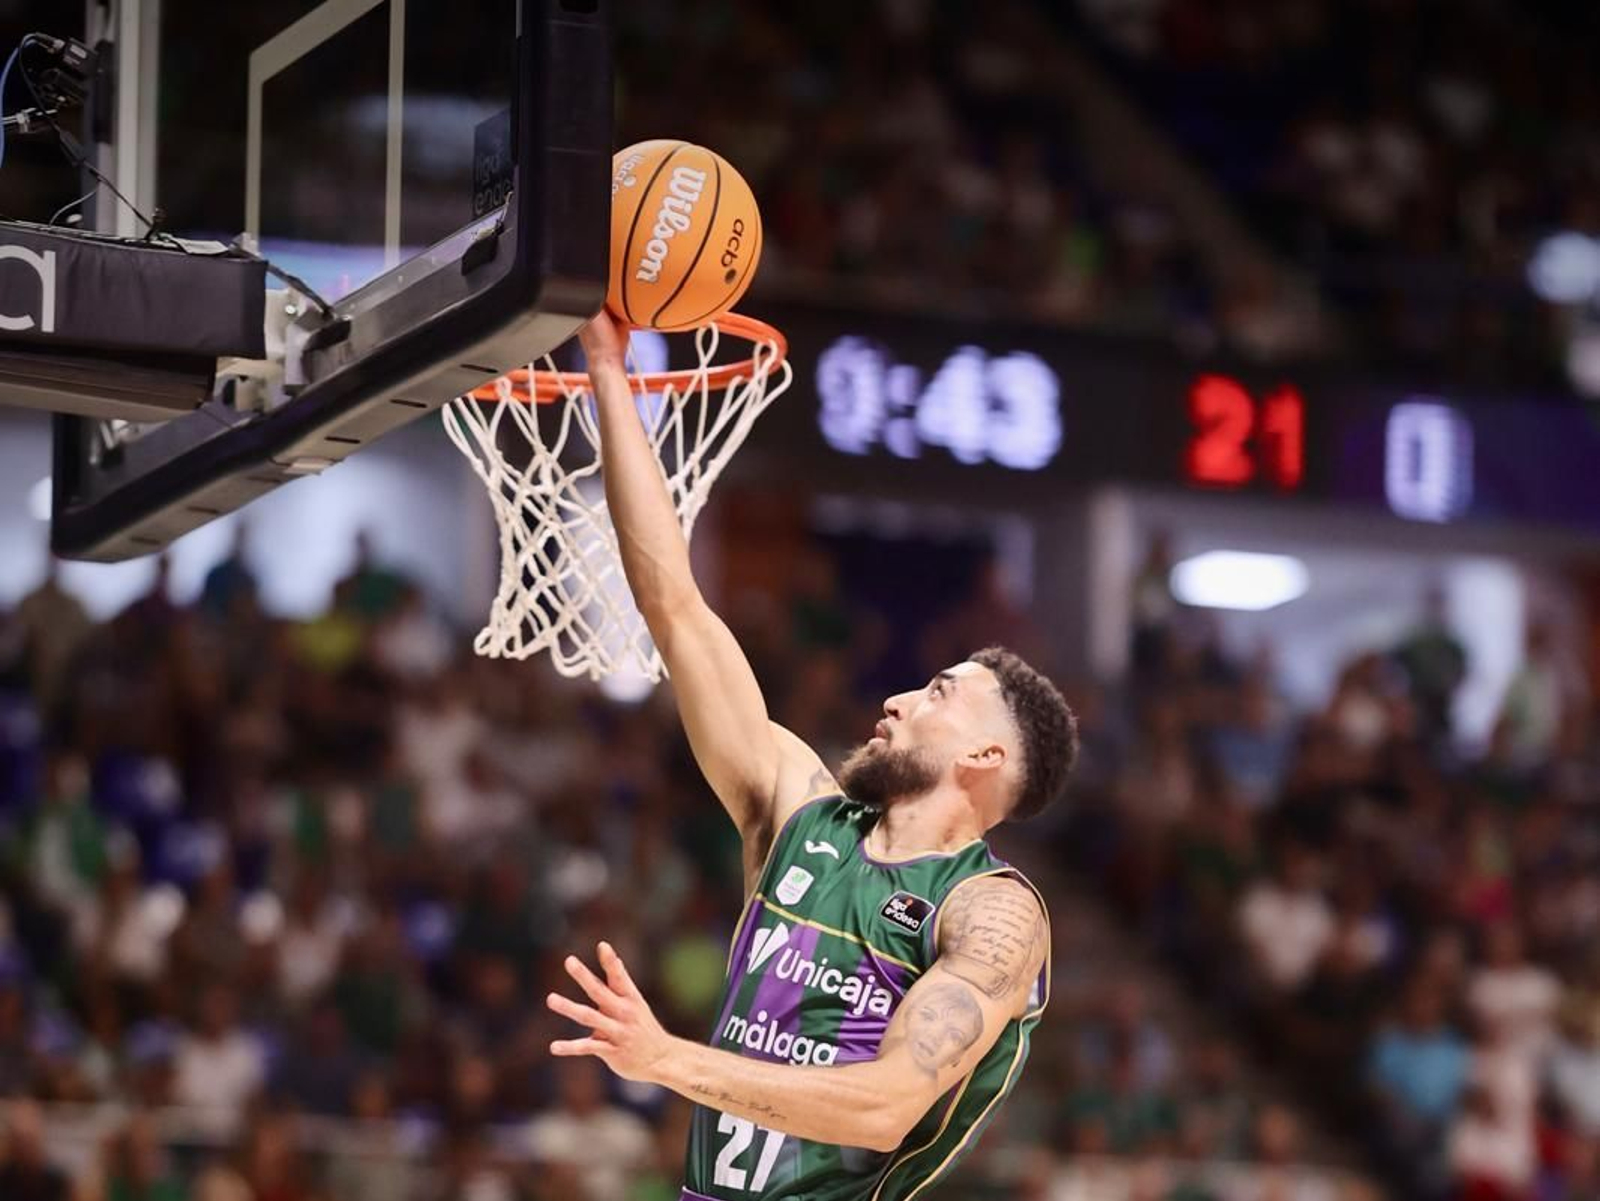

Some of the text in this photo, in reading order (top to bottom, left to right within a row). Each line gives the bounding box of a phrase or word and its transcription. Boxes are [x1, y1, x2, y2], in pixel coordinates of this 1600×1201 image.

[635, 166, 707, 284] Wilson
[720, 218, 745, 268] acb
[1187, 373, 1304, 489] 21
[1384, 398, 1472, 523] 0
[775, 948, 894, 1017] Unicaja
